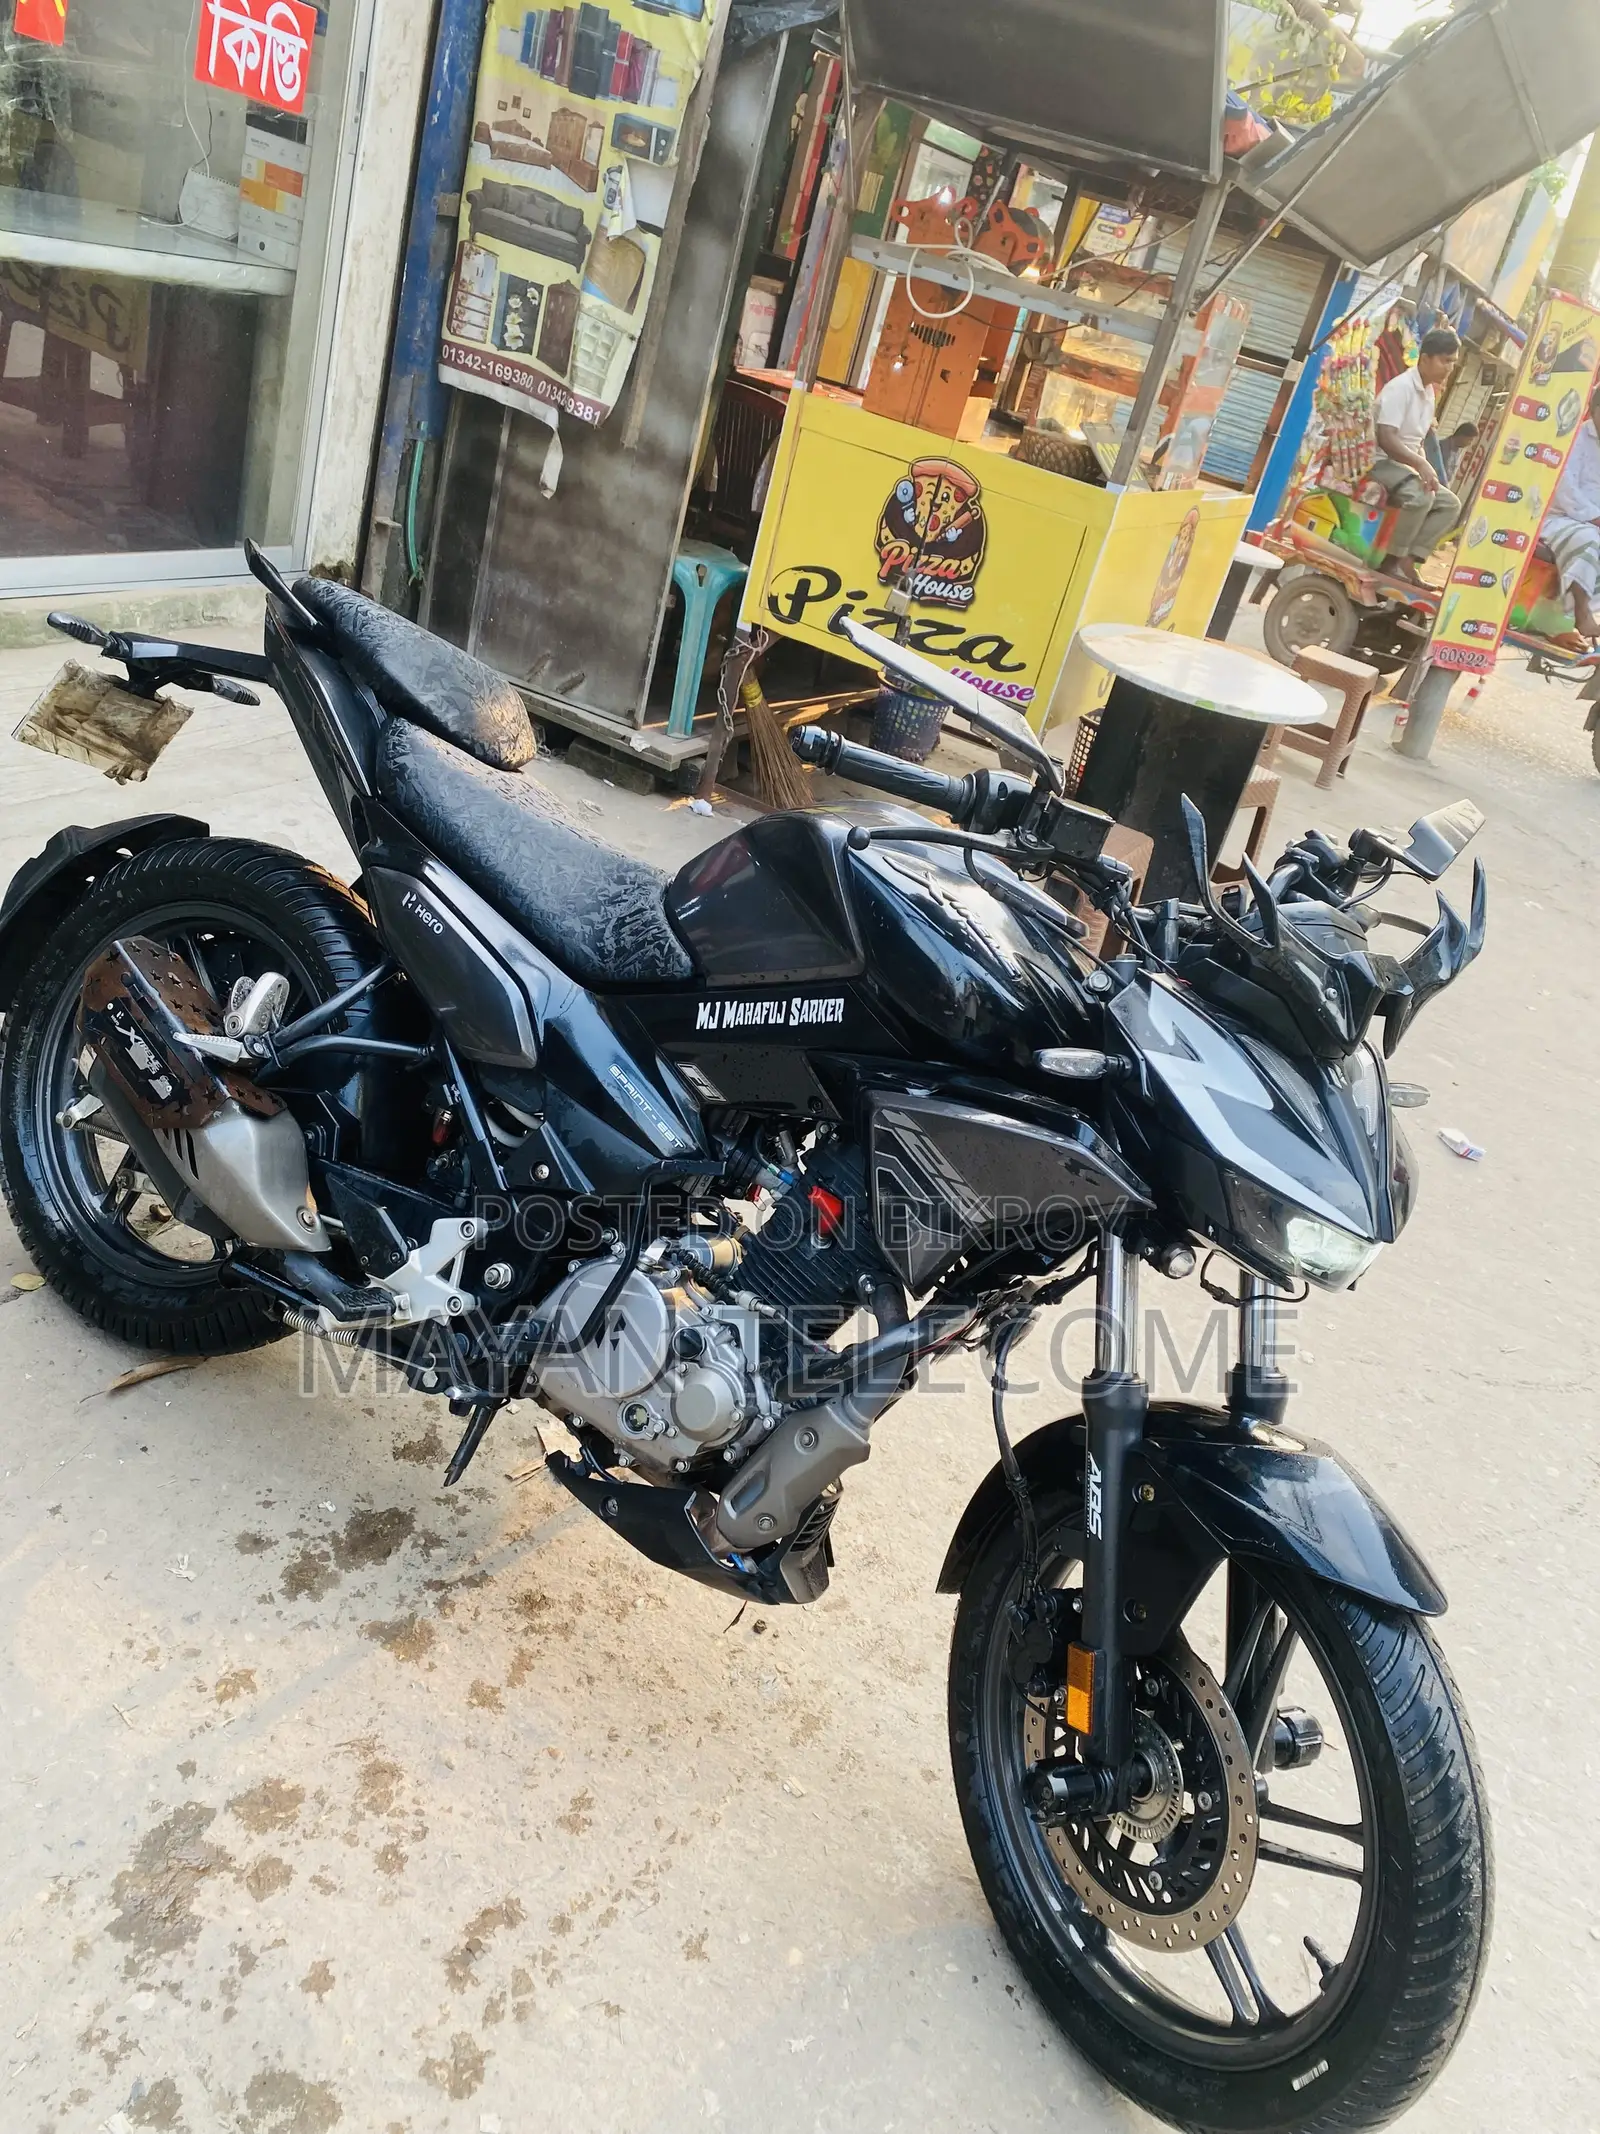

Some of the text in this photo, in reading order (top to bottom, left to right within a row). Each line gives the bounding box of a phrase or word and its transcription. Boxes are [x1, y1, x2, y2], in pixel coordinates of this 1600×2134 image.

[441, 344, 535, 392] 01342-169380,
[881, 541, 961, 580] Pizza
[912, 574, 974, 601] House
[767, 565, 1027, 673] Pizza
[414, 904, 444, 934] Hero
[695, 1001, 721, 1030] MJ
[609, 1064, 653, 1113] SPRINT
[1088, 1450, 1102, 1541] ABS
